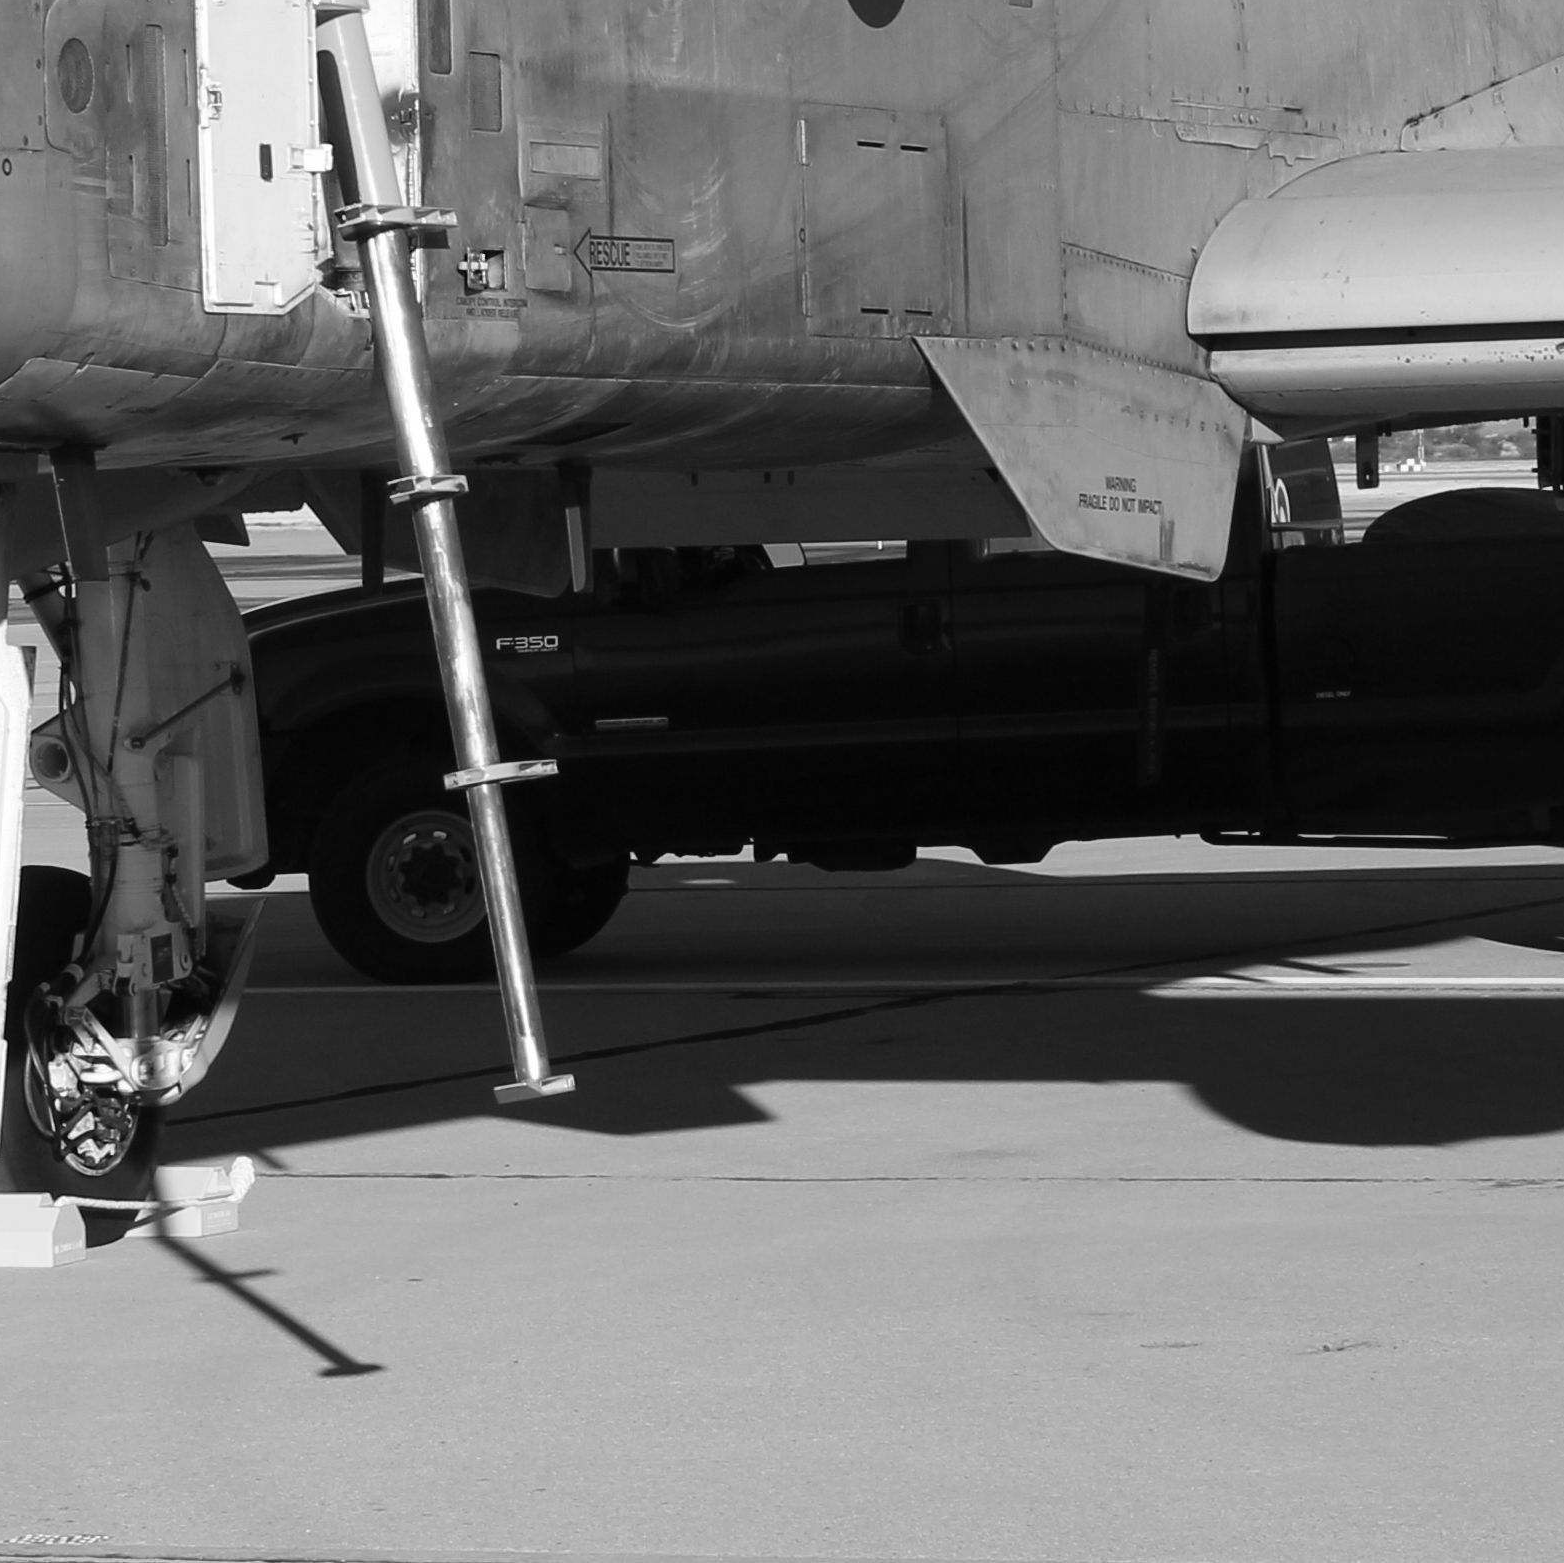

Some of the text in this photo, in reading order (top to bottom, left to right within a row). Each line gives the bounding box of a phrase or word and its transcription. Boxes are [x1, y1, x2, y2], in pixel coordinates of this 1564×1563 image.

[589, 241, 630, 266] RESCUE
[1105, 476, 1137, 493] WARNING
[1078, 493, 1163, 515] FRAGILE DO NOT IMPACT
